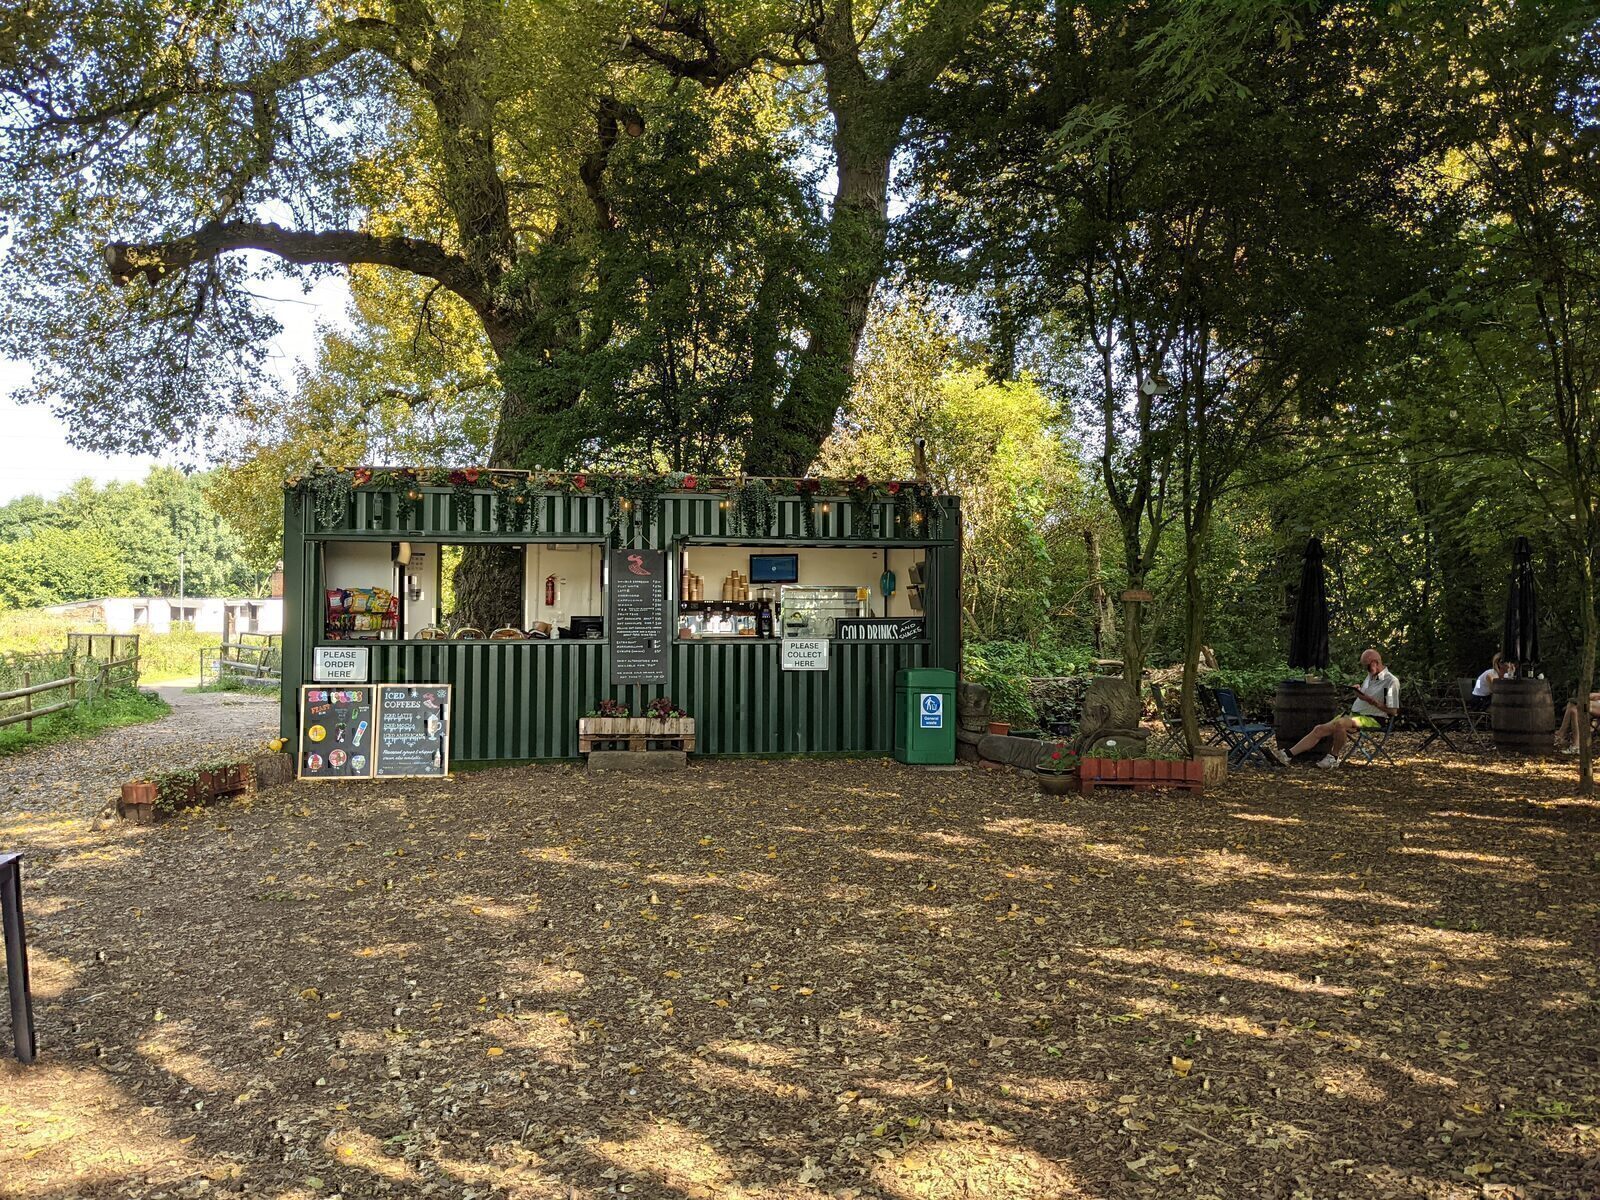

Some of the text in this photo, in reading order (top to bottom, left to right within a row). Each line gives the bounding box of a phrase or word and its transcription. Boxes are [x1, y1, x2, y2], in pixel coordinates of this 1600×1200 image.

[842, 624, 898, 639] COLD DRINKS
[898, 626, 922, 639] SNACKS
[900, 623, 916, 632] AND
[310, 704, 331, 714] FEAST
[397, 713, 413, 721] LATTE
